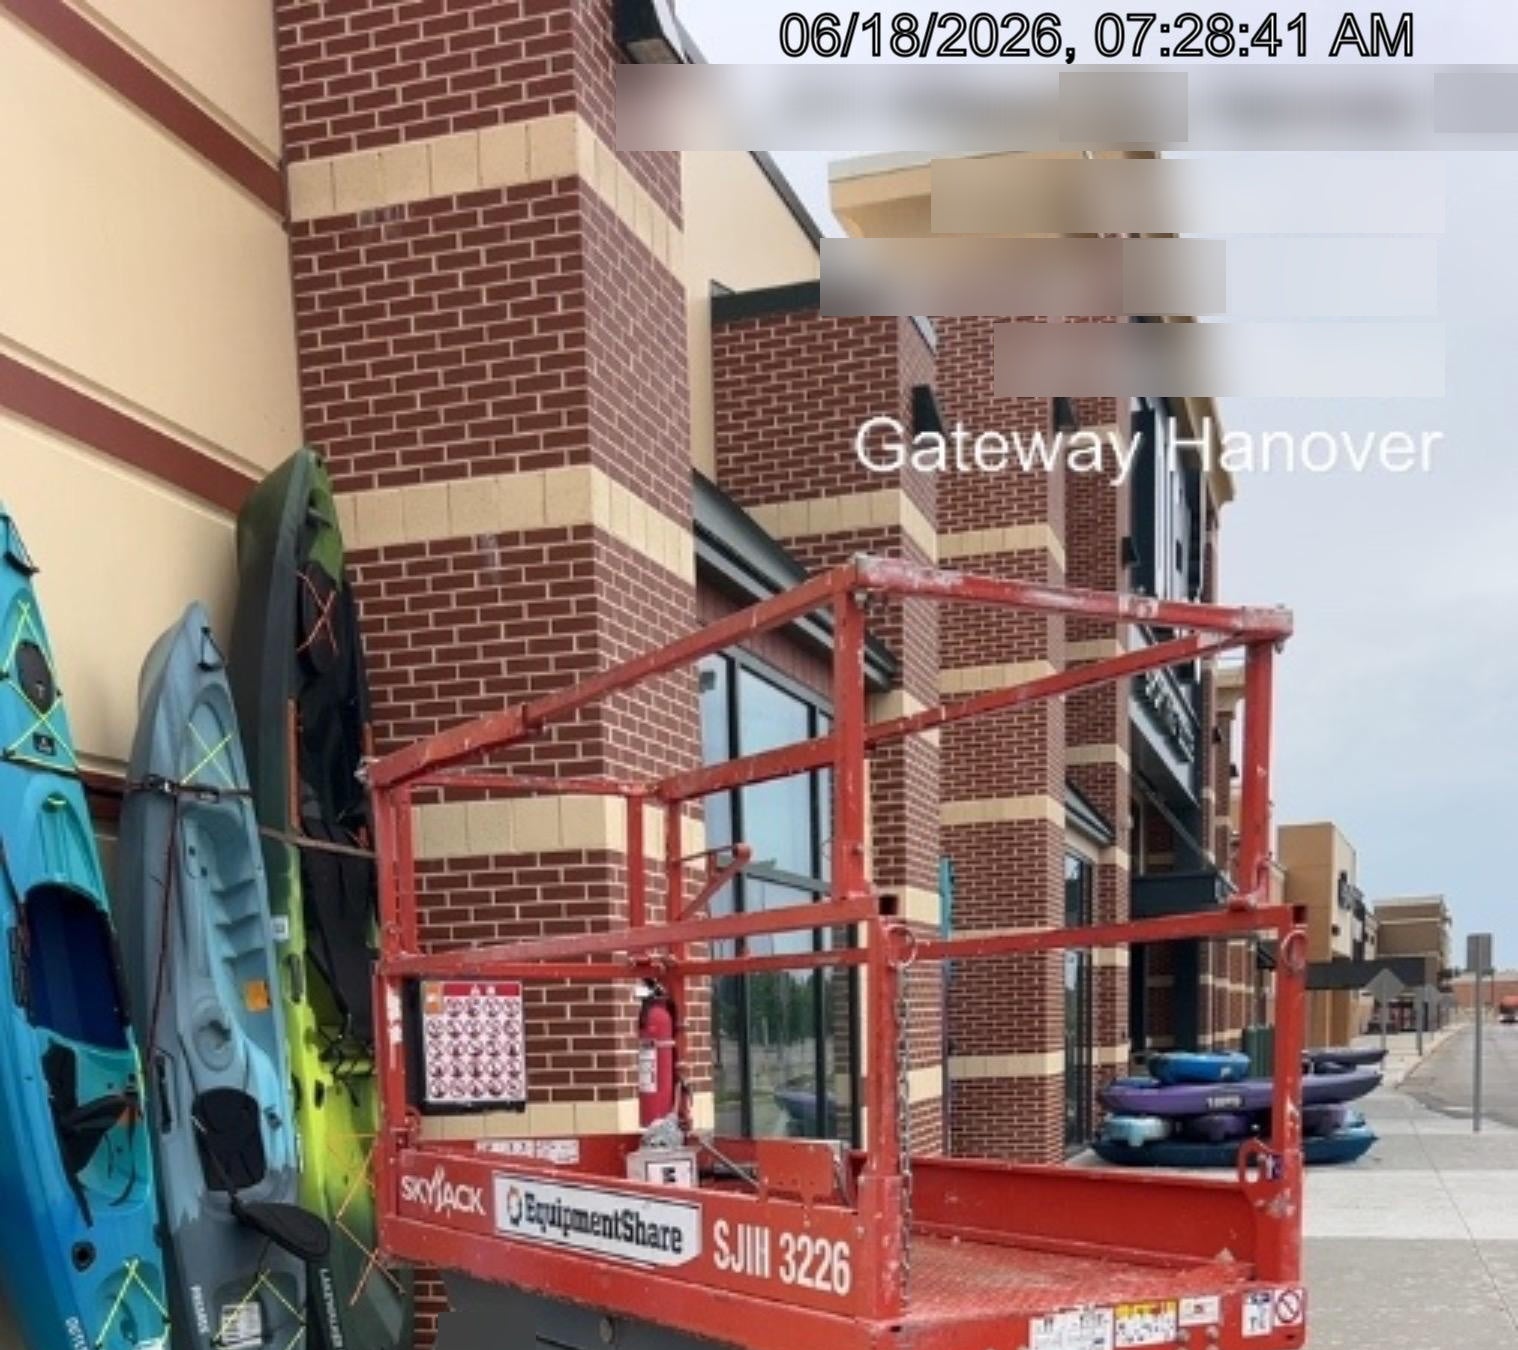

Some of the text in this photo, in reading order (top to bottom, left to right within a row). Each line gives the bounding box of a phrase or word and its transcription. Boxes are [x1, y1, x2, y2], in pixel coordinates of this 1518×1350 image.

[401, 1166, 487, 1218] SKYJACK
[524, 1192, 682, 1255] EquipmentShare
[779, 1231, 851, 1297] 3226
